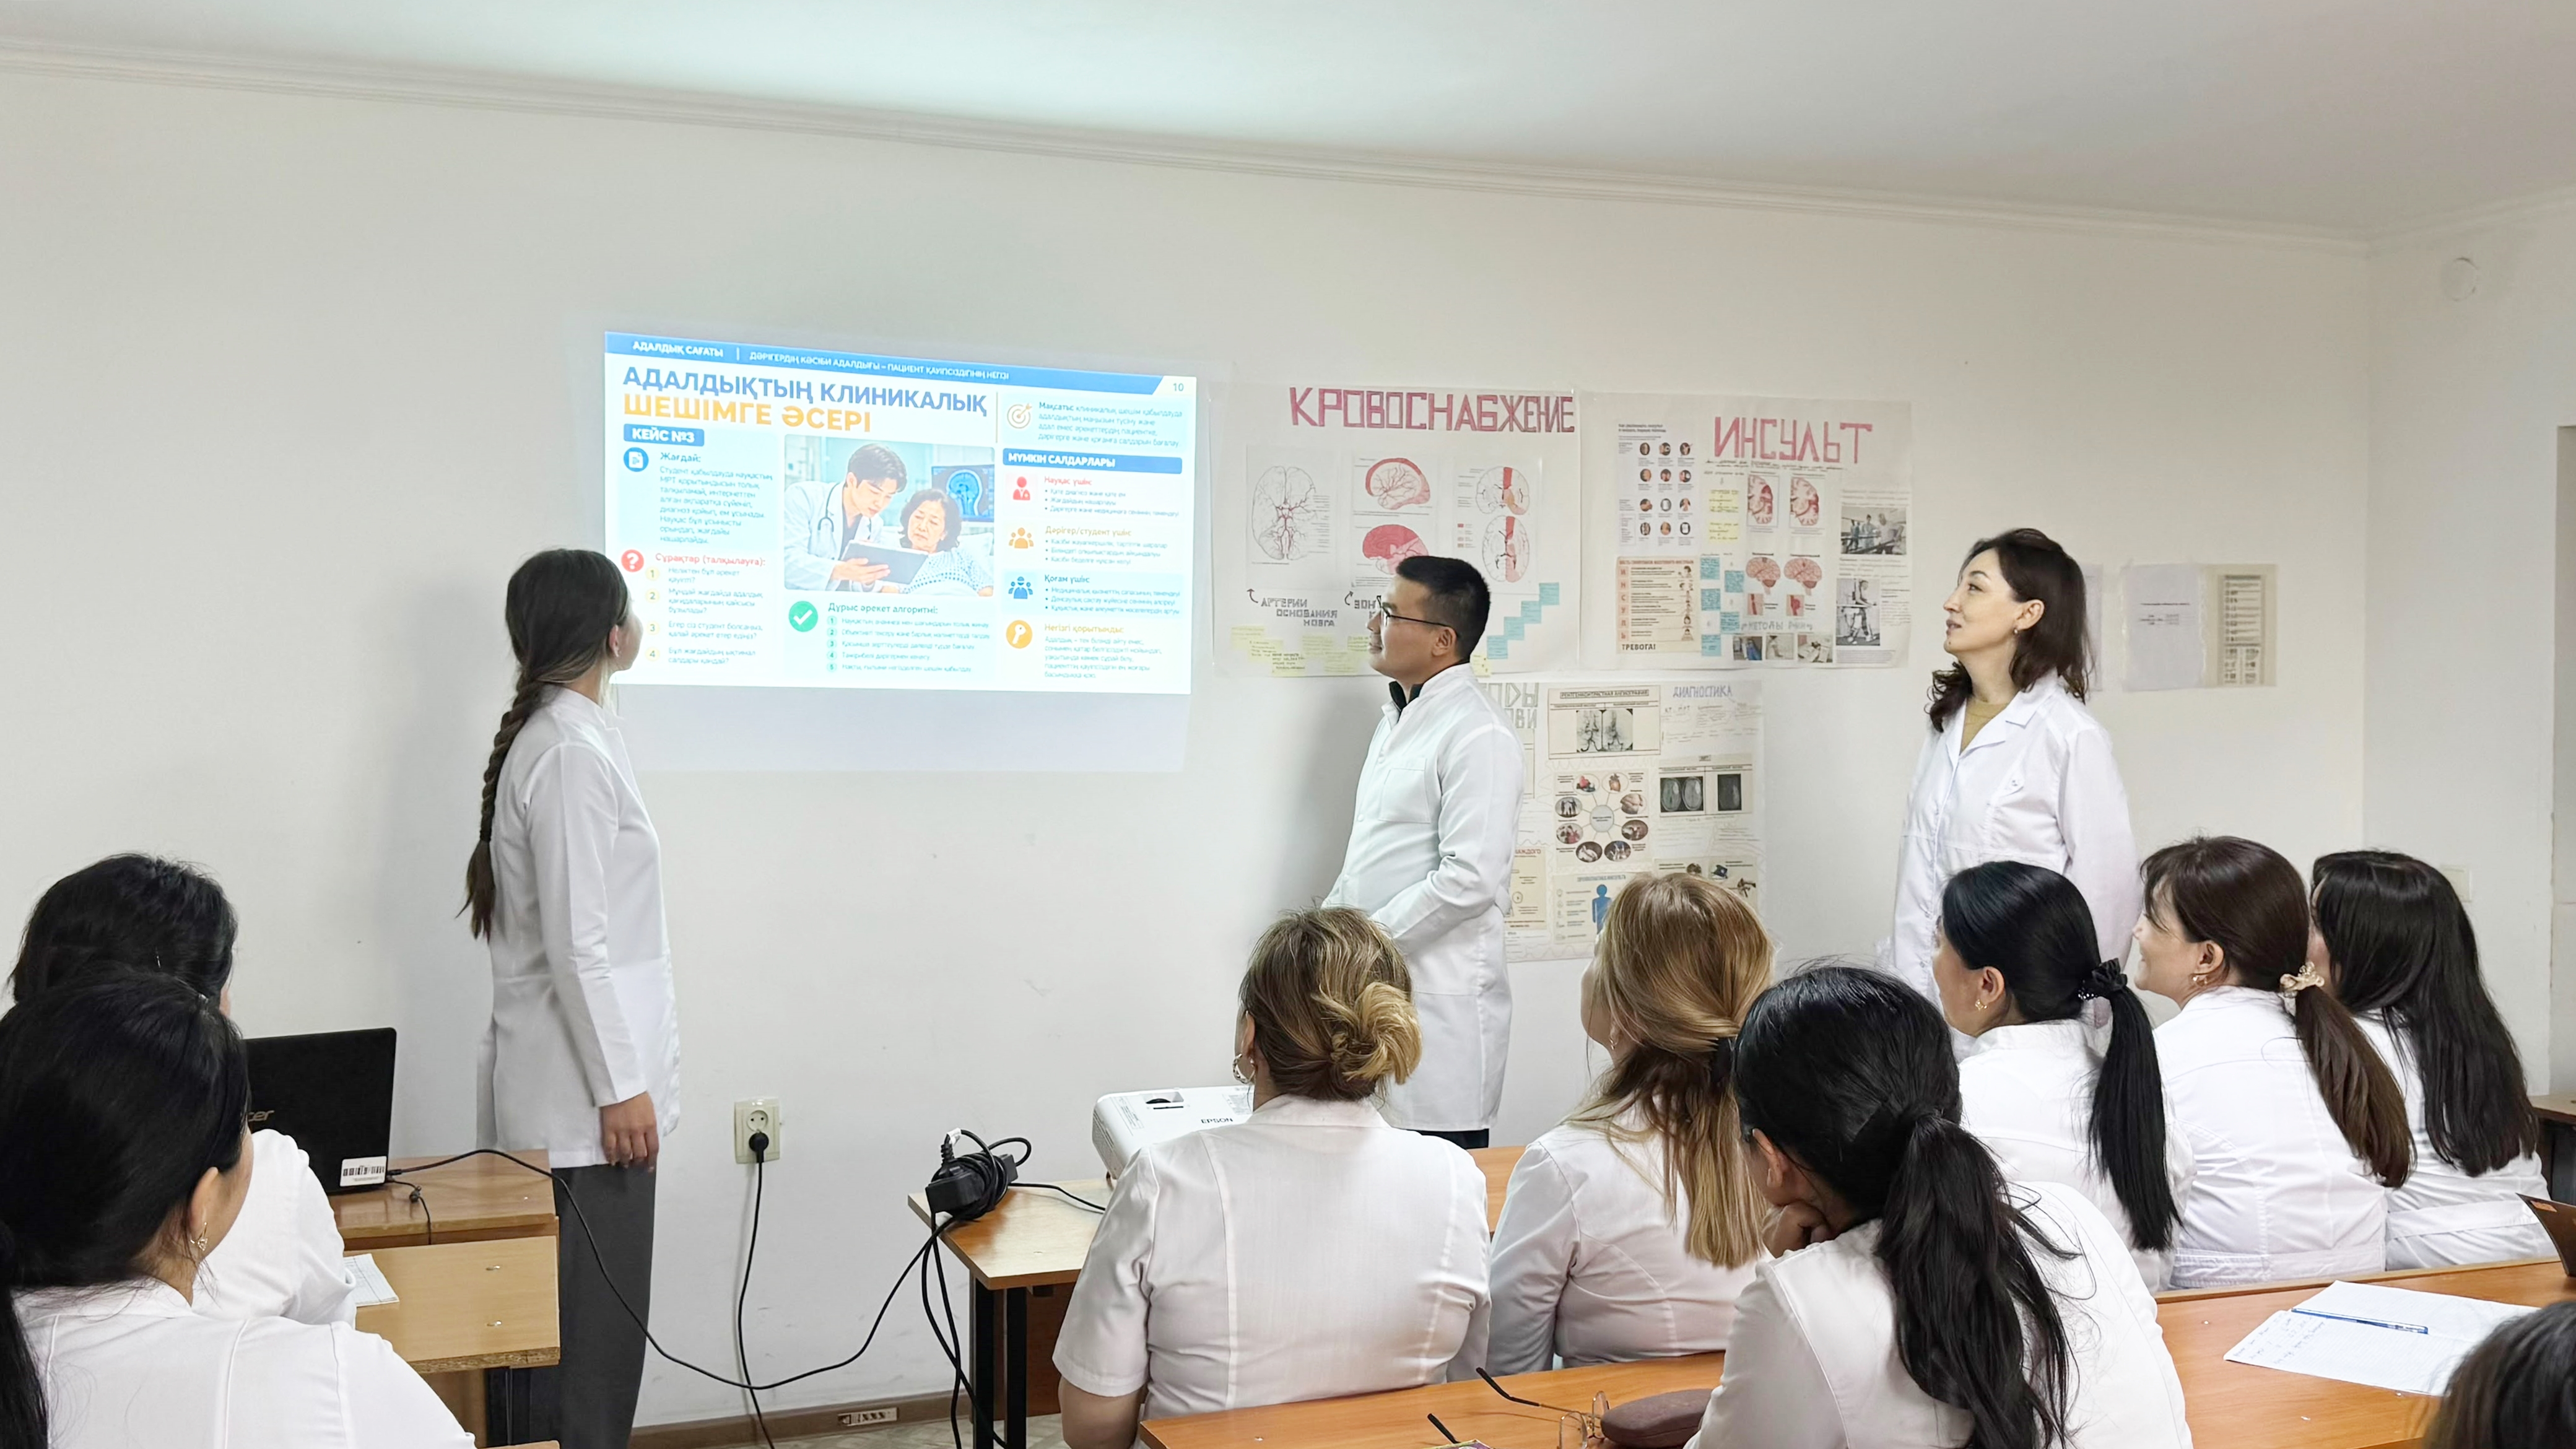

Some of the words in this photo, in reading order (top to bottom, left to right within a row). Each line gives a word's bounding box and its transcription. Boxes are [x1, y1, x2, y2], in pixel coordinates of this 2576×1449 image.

[633, 341, 684, 355] АДАЛДЫҚ
[685, 346, 723, 357] САҒАТЫ
[801, 357, 832, 366] КӘСІБИ
[833, 359, 879, 370] АДАЛДЫҒЫ
[888, 363, 924, 373] ПАЦИЕНТ
[623, 367, 813, 404] АДАЛДЫҚТЫҢ
[821, 383, 987, 417] КЛИНИКАЛЫҚ
[1173, 383, 1184, 391] 10
[624, 393, 772, 425] ШЕШІМГЕ
[781, 406, 870, 432] ӘСЕРІ
[1289, 387, 1575, 432] КРОВОСНАБЖЕНИЕ
[632, 427, 669, 442] КЕЙС
[671, 431, 694, 443] №3
[1715, 417, 1873, 464] ИНСУЛЬТ
[661, 452, 701, 462] Жағдай:
[1009, 453, 1046, 464] МҮМКІН
[1048, 455, 1115, 468] САЛДАРЛАРЫ
[1045, 476, 1070, 485] Науқас
[1045, 526, 1110, 536] Дәрігер/студент
[703, 555, 765, 567] (талқылауға):
[651, 570, 654, 578] 1
[1045, 575, 1068, 583] Қоғам
[861, 605, 890, 613] әрекет
[1261, 598, 1307, 608] АРТЕРИИ
[1277, 609, 1338, 618] ОСНОВАНИЯ
[1045, 624, 1070, 632] Негізгі
[1673, 685, 1733, 698] ДИАГНОСТИКА
[247, 1110, 275, 1122] cer
